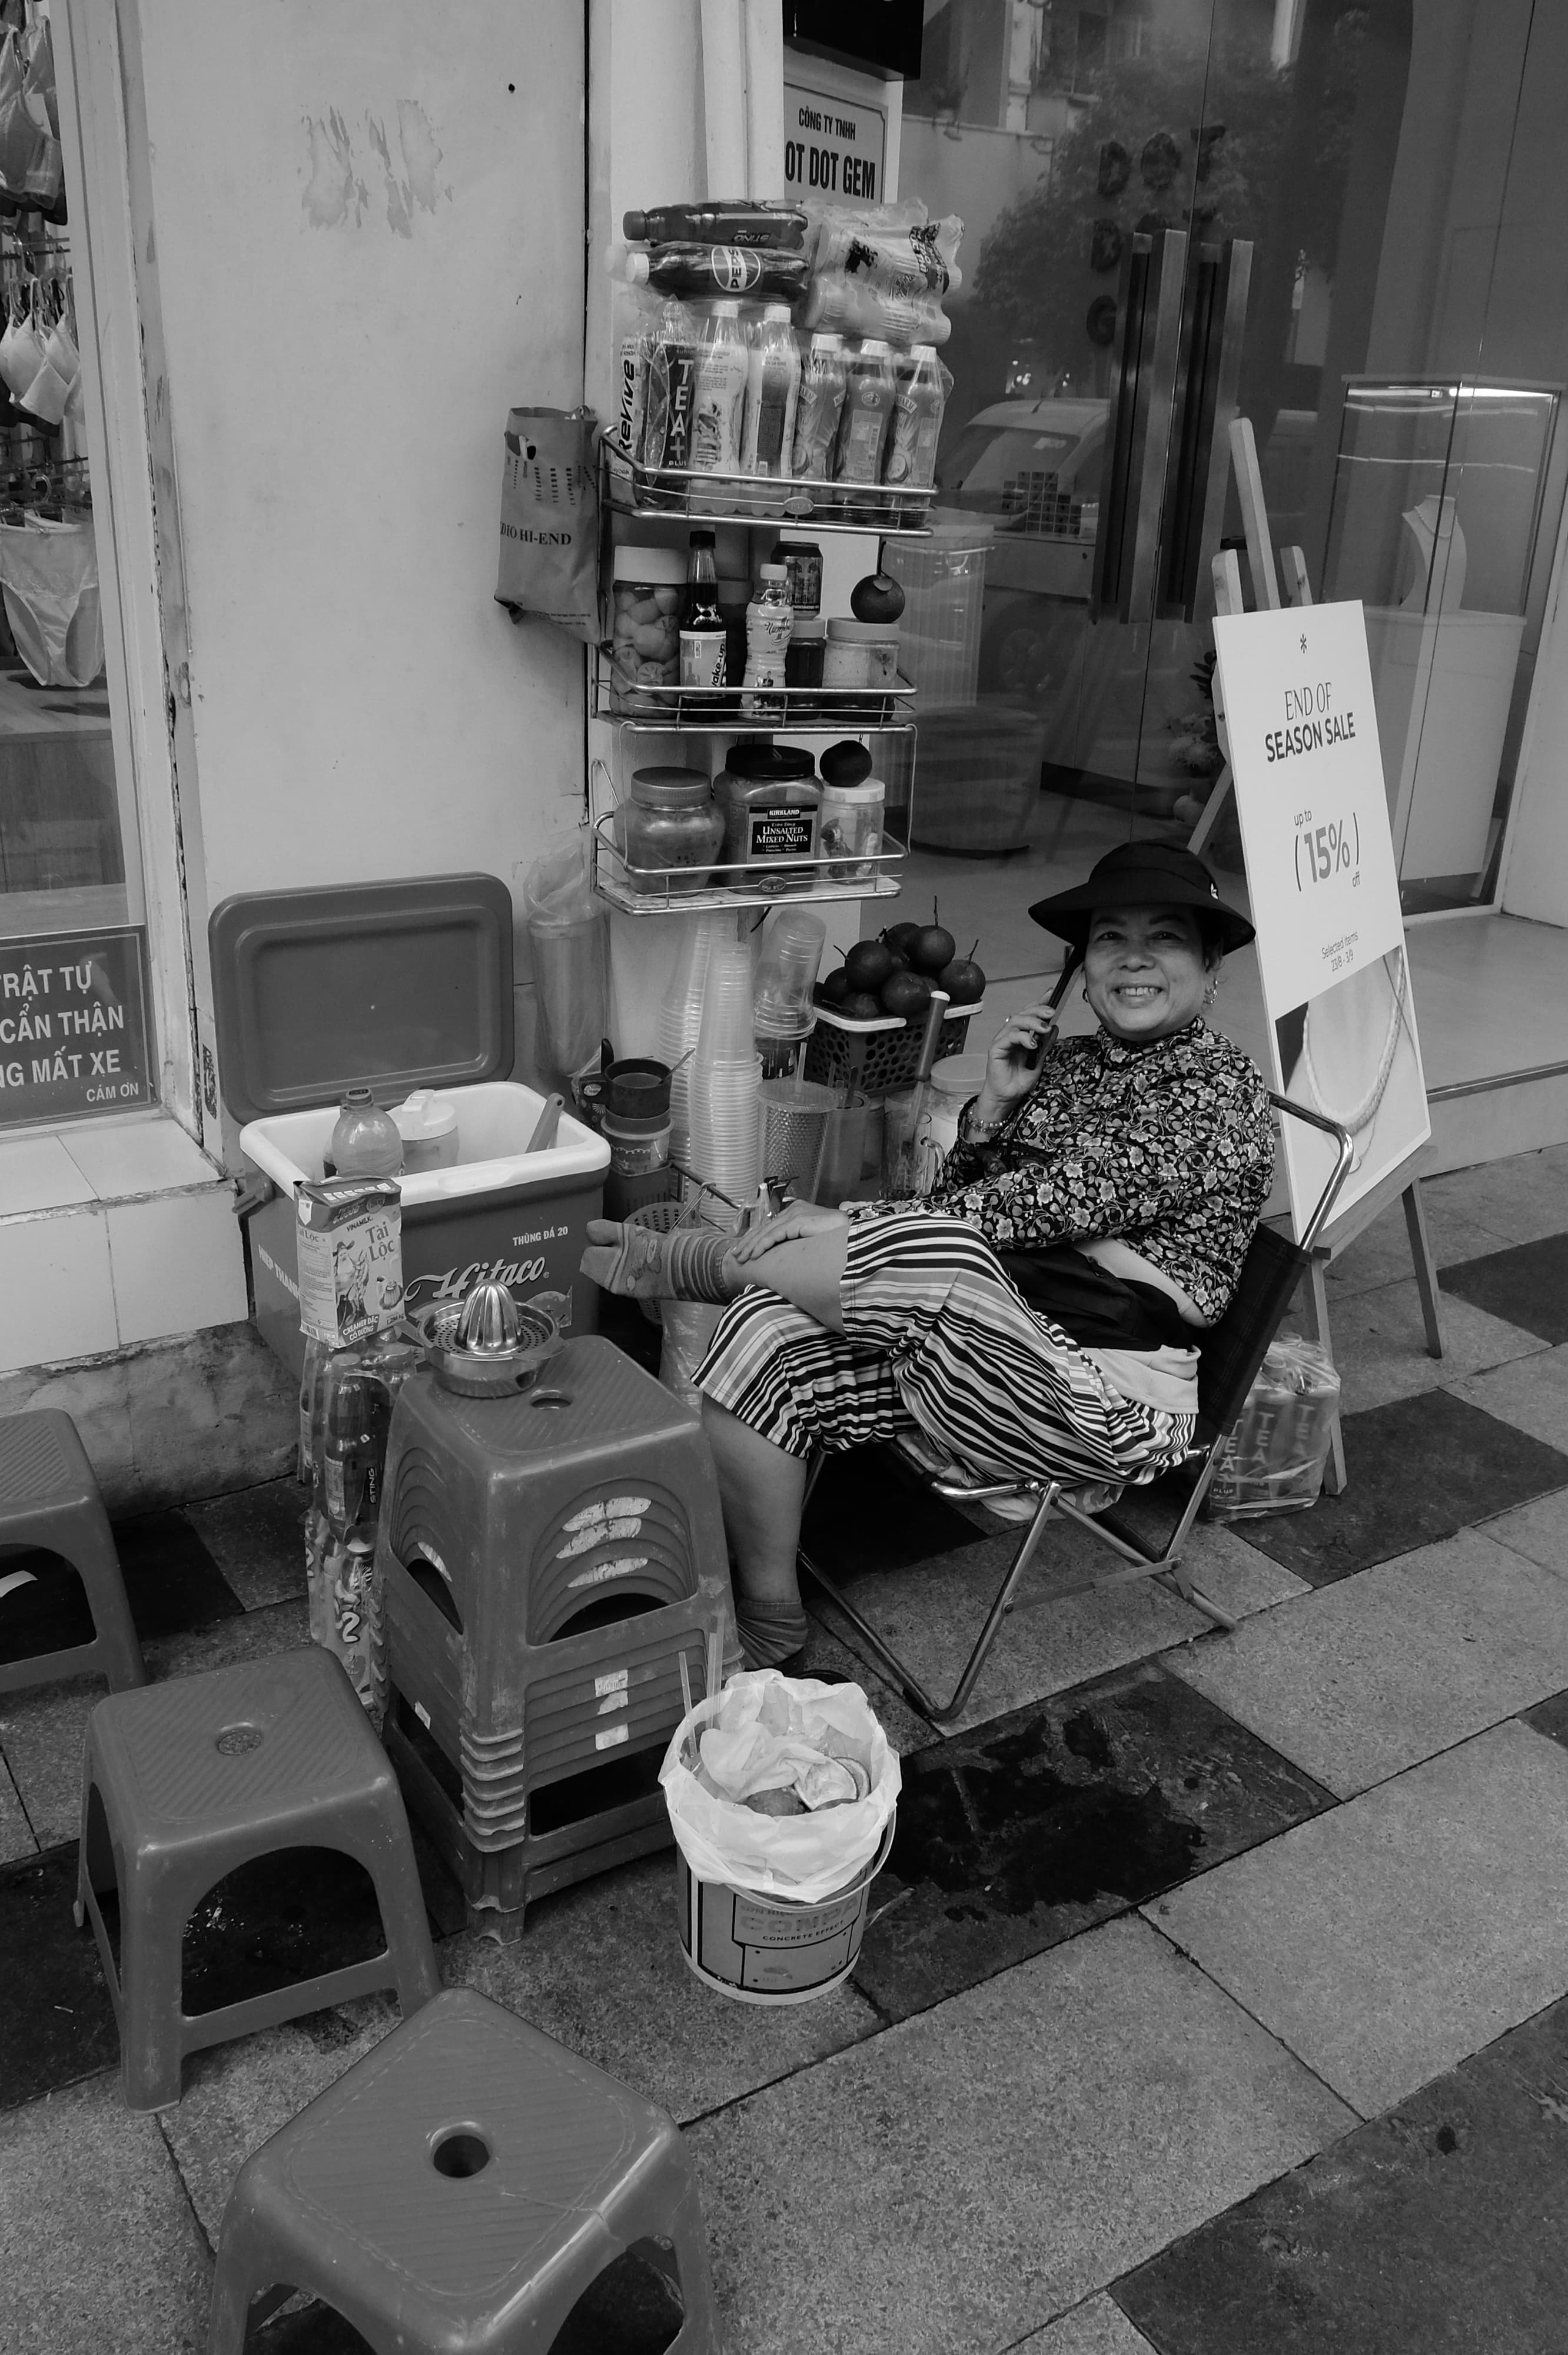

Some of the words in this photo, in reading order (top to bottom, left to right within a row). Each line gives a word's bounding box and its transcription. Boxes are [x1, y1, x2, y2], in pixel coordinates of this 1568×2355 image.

[799, 105, 822, 131] CÔNG
[824, 114, 833, 135] TY
[835, 118, 856, 141] TNHH
[809, 145, 839, 191] DOT
[843, 155, 876, 200] GEM
[520, 529, 572, 546] HI-END
[1284, 686, 1313, 721] END
[1316, 682, 1332, 713] OF
[1265, 721, 1323, 762] SEASON
[1324, 711, 1356, 745] SALE
[1294, 813, 1304, 829] up
[1304, 808, 1313, 822] to
[1352, 871, 1361, 887] off
[1321, 937, 1344, 959] Selected
[0, 964, 52, 1001] RẬT
[59, 960, 92, 994] TỰ
[0, 1003, 52, 1044] CẨN
[58, 1001, 124, 1037] THẬN
[32, 1046, 83, 1084] MẤT
[89, 1049, 121, 1076] XE
[87, 1084, 117, 1102] CÁM
[120, 1082, 139, 1097] ƠN
[346, 1217, 373, 1232] VINAMILK
[365, 1222, 390, 1245] Tài
[513, 1232, 542, 1246] THÙNG
[543, 1226, 555, 1240] ĐÁ
[557, 1226, 569, 1237] 20
[368, 1240, 396, 1263] Lộc
[404, 1256, 546, 1302] Hitaco
[343, 1319, 367, 1335] CREAMER
[368, 1468, 377, 1504] STING
[762, 1932, 813, 1942] CONCRETE
[816, 1919, 845, 1936] EFFECT
